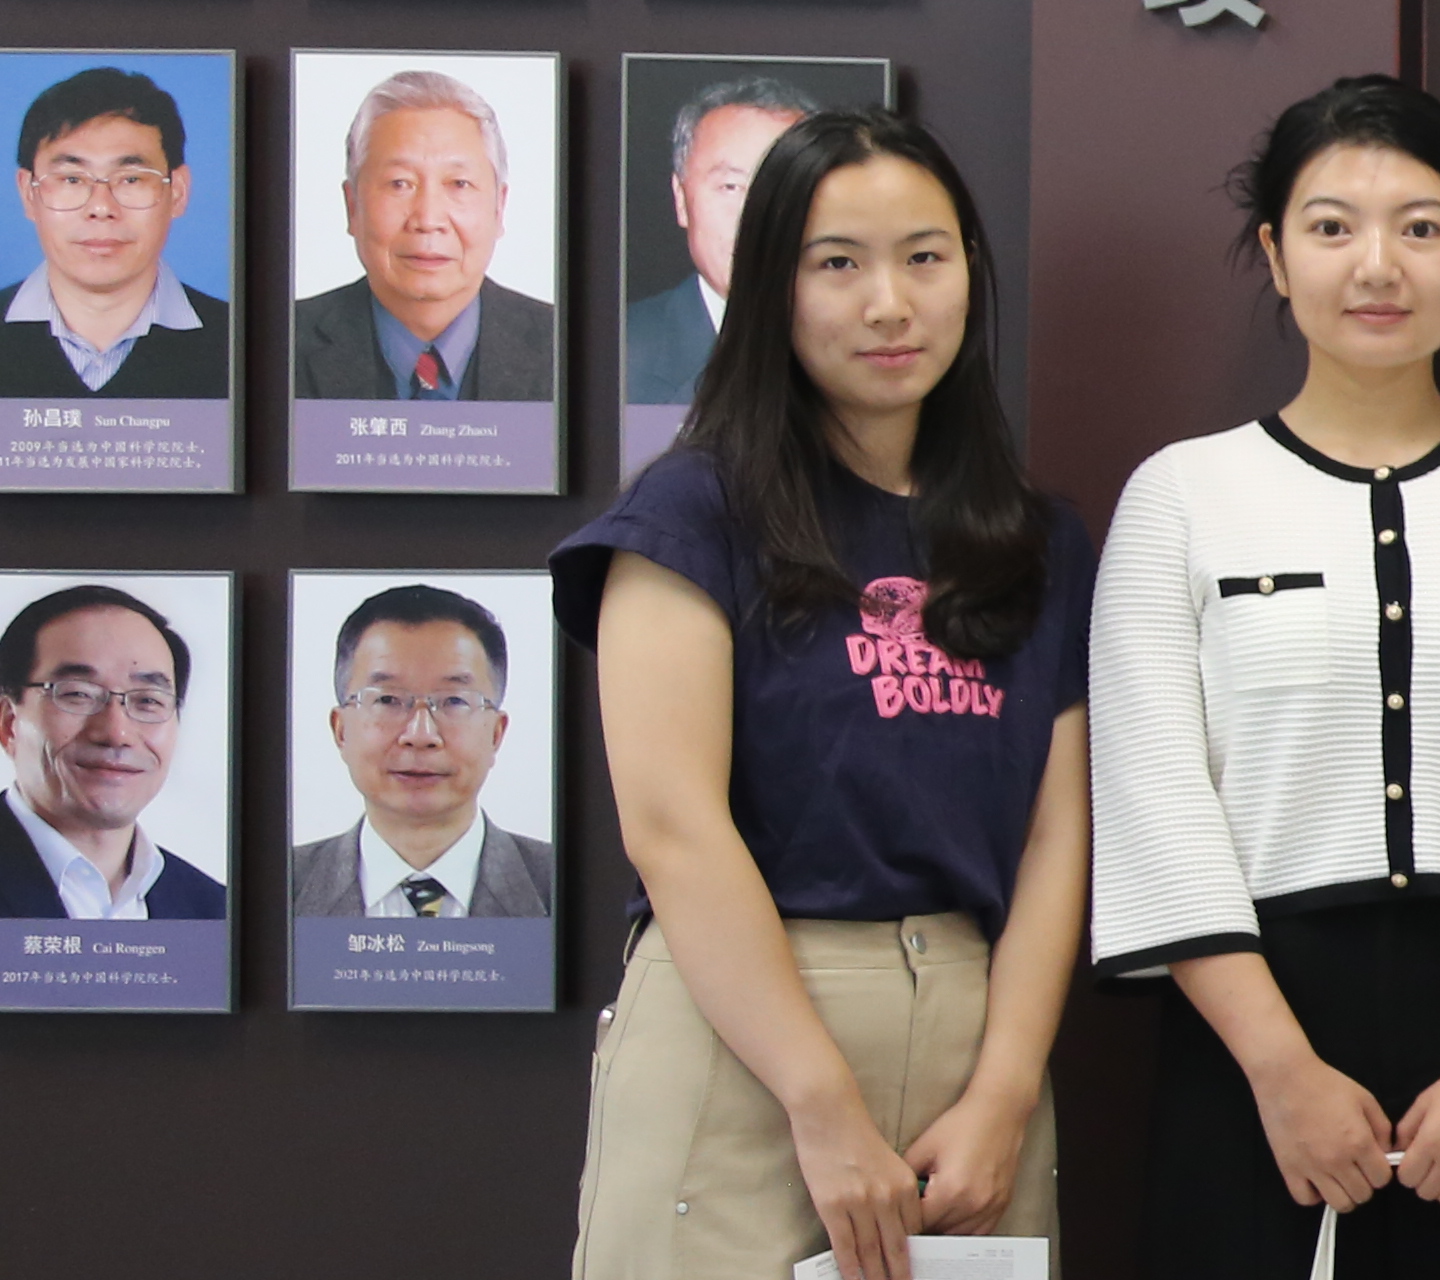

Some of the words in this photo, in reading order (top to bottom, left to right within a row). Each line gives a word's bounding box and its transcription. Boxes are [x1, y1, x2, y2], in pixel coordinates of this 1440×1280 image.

[23, 408, 83, 428] 孙昌璞
[94, 415, 117, 427] Sun
[119, 415, 170, 429] Changpu
[350, 417, 408, 437] 张肇西
[420, 424, 456, 438] Zhang
[458, 424, 498, 437] Zhaoxi
[846, 633, 986, 679] DREAM
[871, 674, 1005, 719] BOLDLY
[23, 935, 82, 955] 蔡荣根
[92, 942, 113, 954] Cai
[115, 942, 166, 957] Ronggen
[348, 933, 406, 953] 邹冰松
[416, 940, 440, 952] Zou
[443, 940, 496, 955] Bingsong
